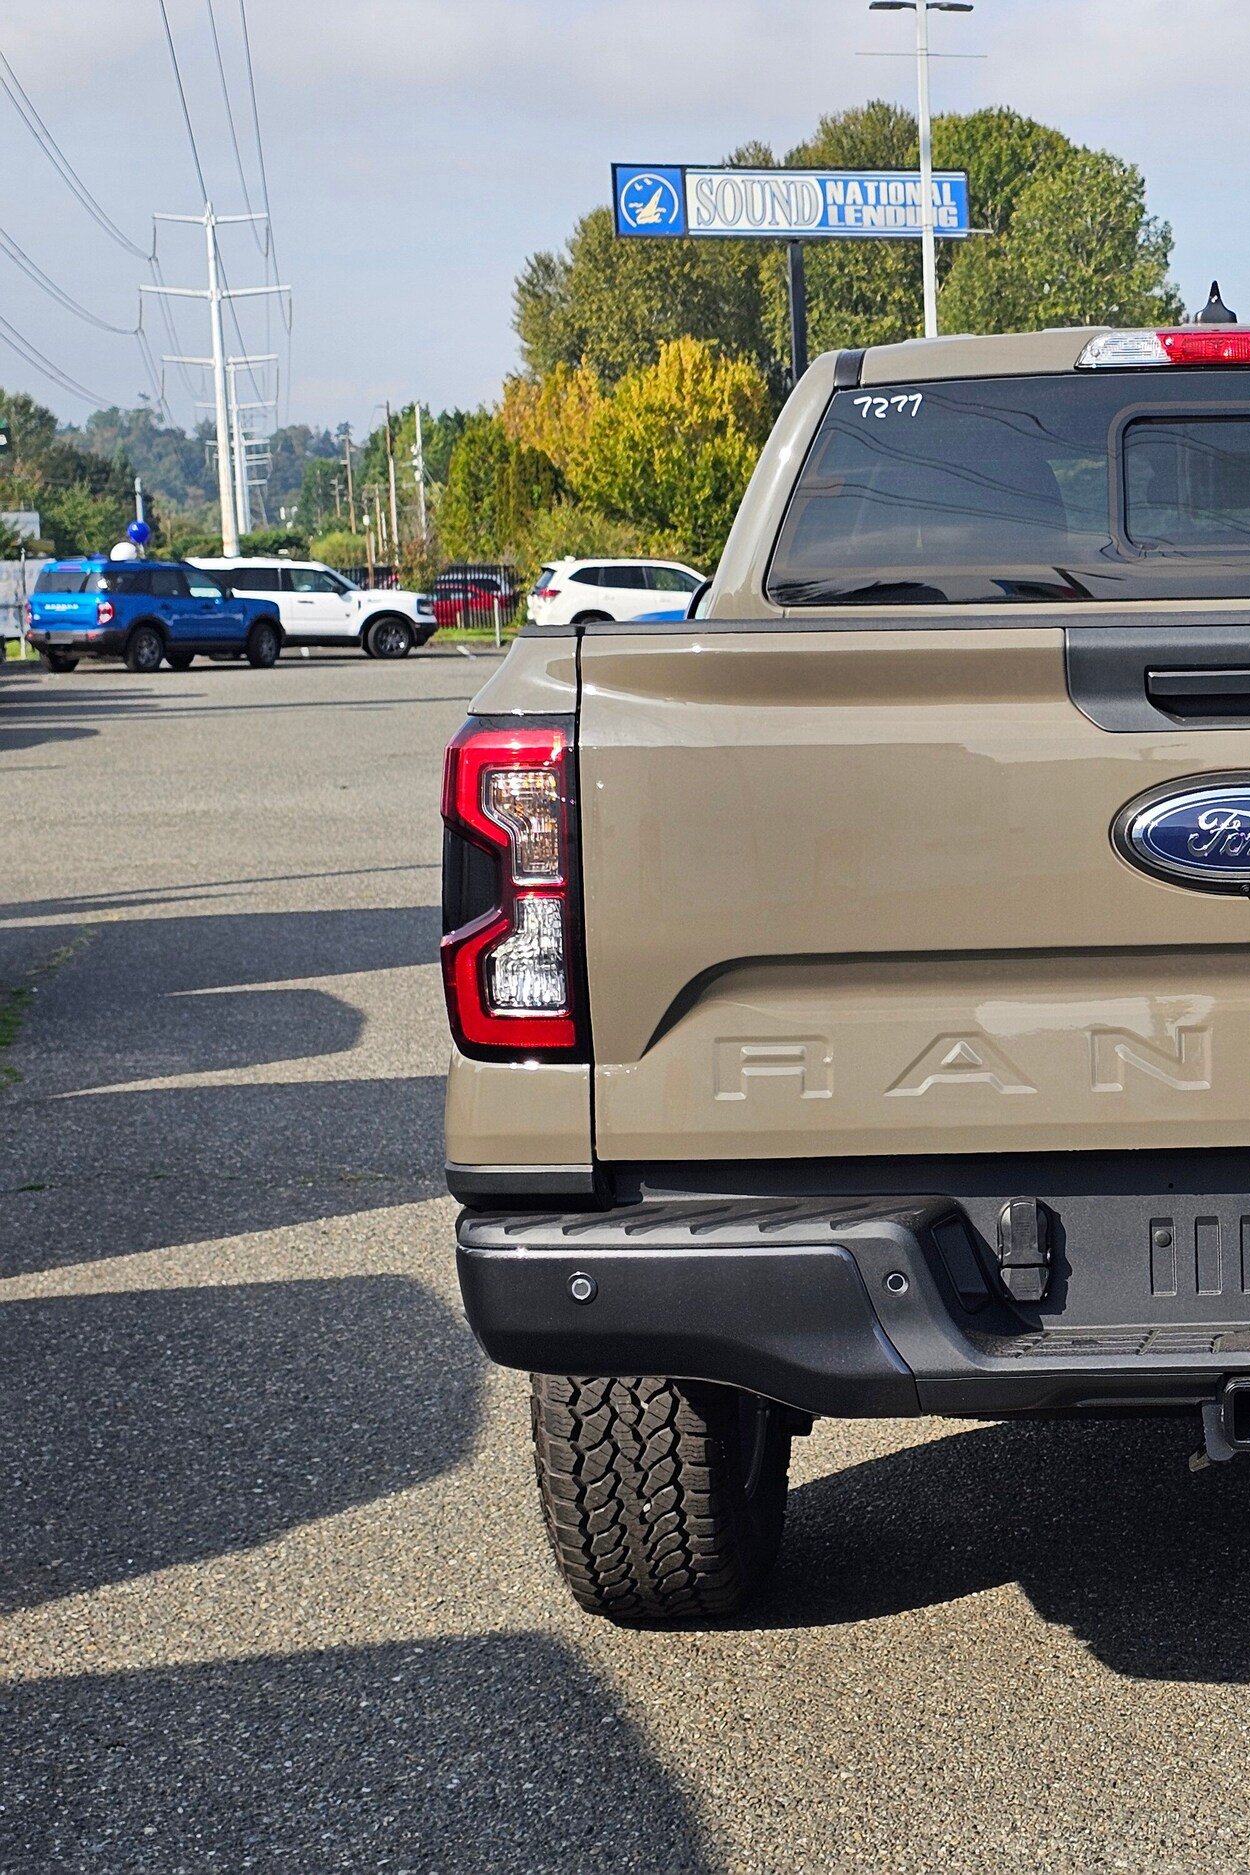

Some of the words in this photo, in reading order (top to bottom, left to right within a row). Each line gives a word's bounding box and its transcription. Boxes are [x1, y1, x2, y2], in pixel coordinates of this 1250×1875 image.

[696, 178, 819, 227] SOUND
[825, 180, 956, 206] NATIONAL
[853, 393, 923, 418] 7277
